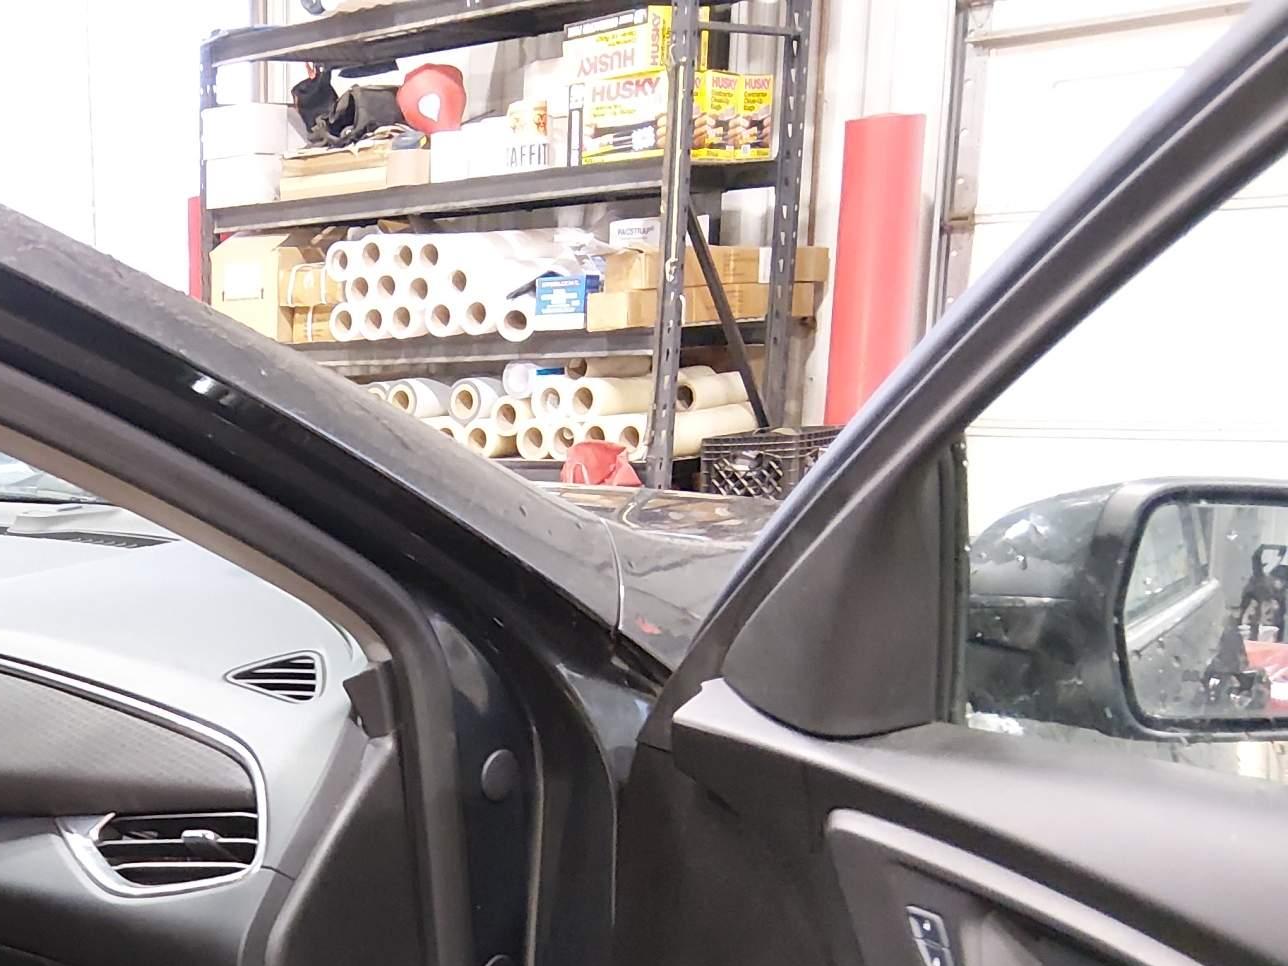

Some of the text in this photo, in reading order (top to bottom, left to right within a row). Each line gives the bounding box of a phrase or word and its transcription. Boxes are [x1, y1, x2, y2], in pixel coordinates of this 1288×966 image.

[650, 12, 661, 66] HUSKY
[577, 47, 635, 78] HUSKY
[592, 76, 662, 103] HUSKY
[712, 76, 738, 90] HUSKY
[744, 77, 772, 90] HUSKY
